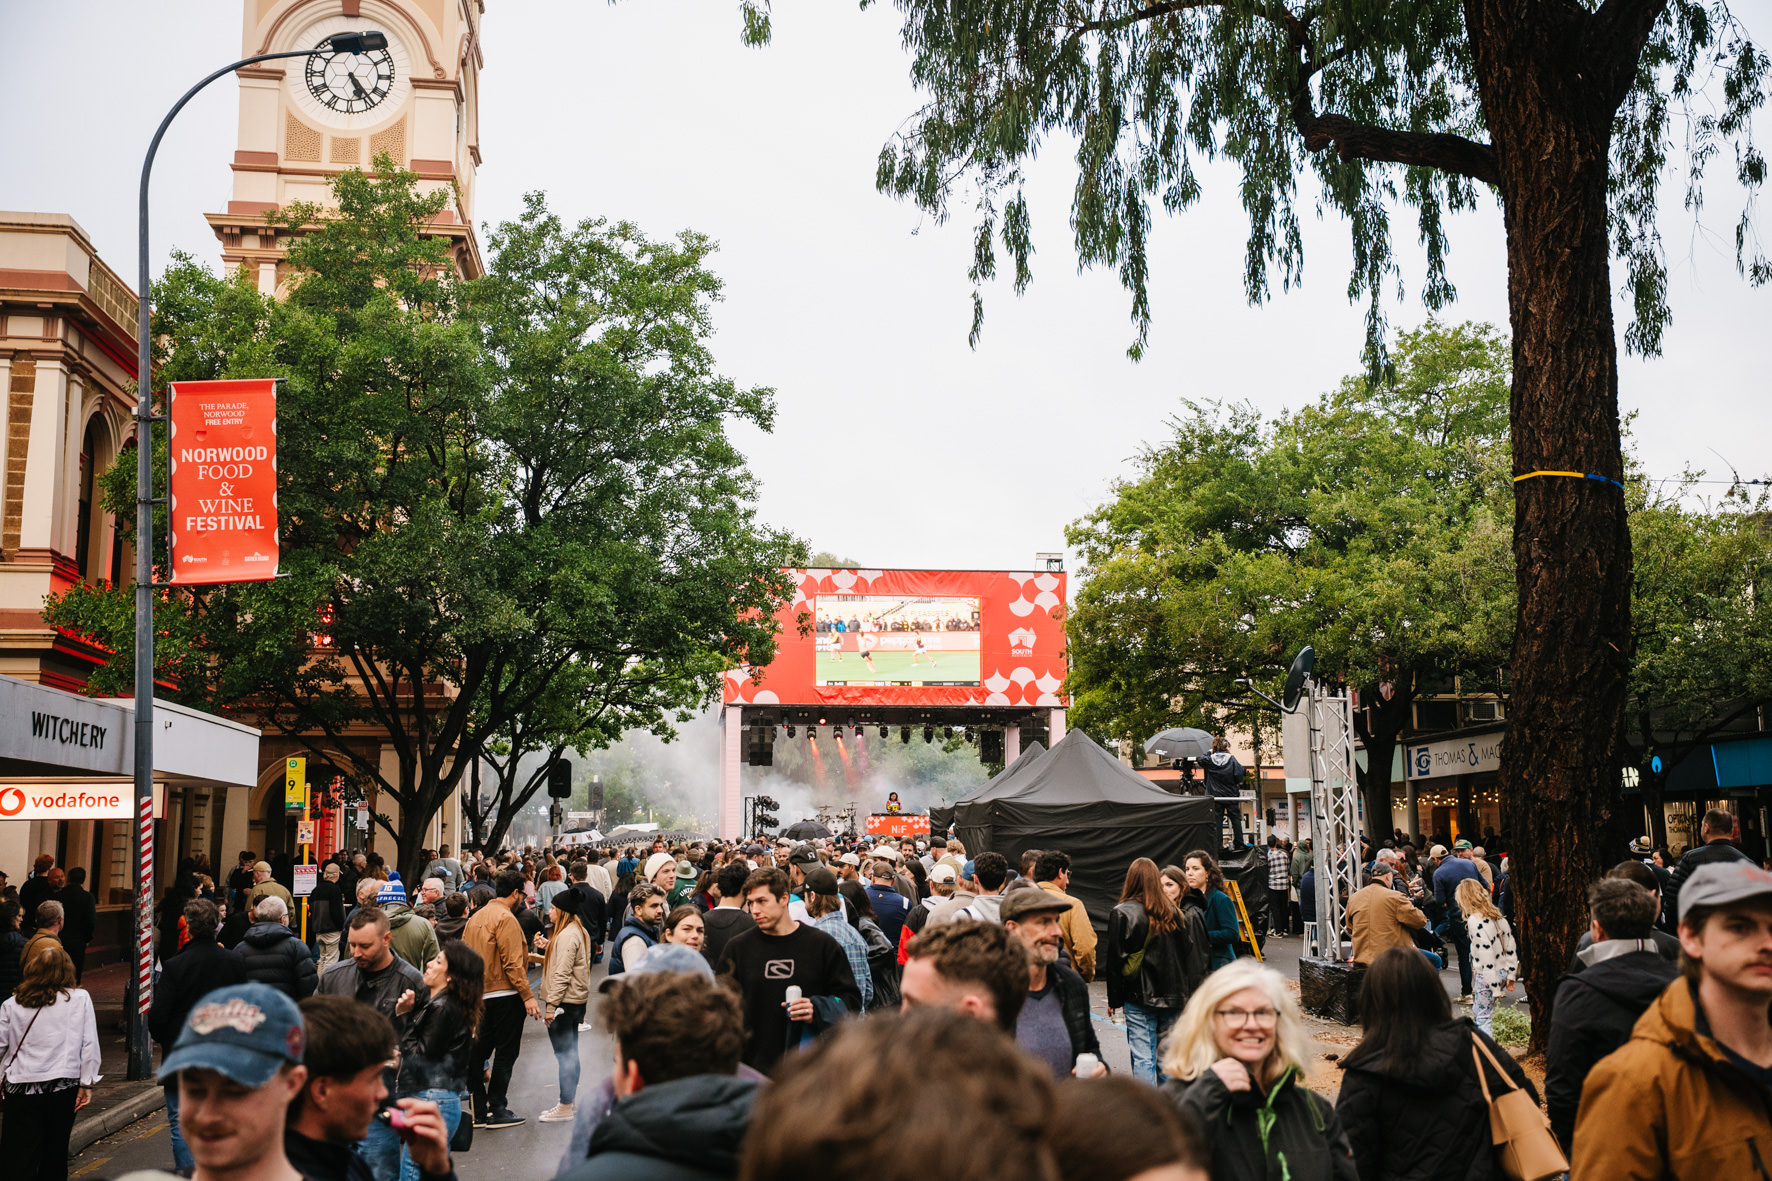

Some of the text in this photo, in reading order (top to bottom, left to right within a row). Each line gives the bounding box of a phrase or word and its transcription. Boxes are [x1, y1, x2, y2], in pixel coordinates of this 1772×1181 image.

[203, 410, 245, 418] NORWOOD
[182, 446, 267, 463] NORWOOD
[197, 464, 252, 479] FOOD
[220, 482, 235, 496] &
[199, 498, 254, 513] WINE
[186, 515, 264, 531] FESTIVAL
[32, 711, 107, 750] WITCHERY
[1434, 749, 1465, 766] THOMAS
[1468, 743, 1479, 766] &
[288, 780, 295, 790] 9
[32, 793, 120, 808] vodafone
